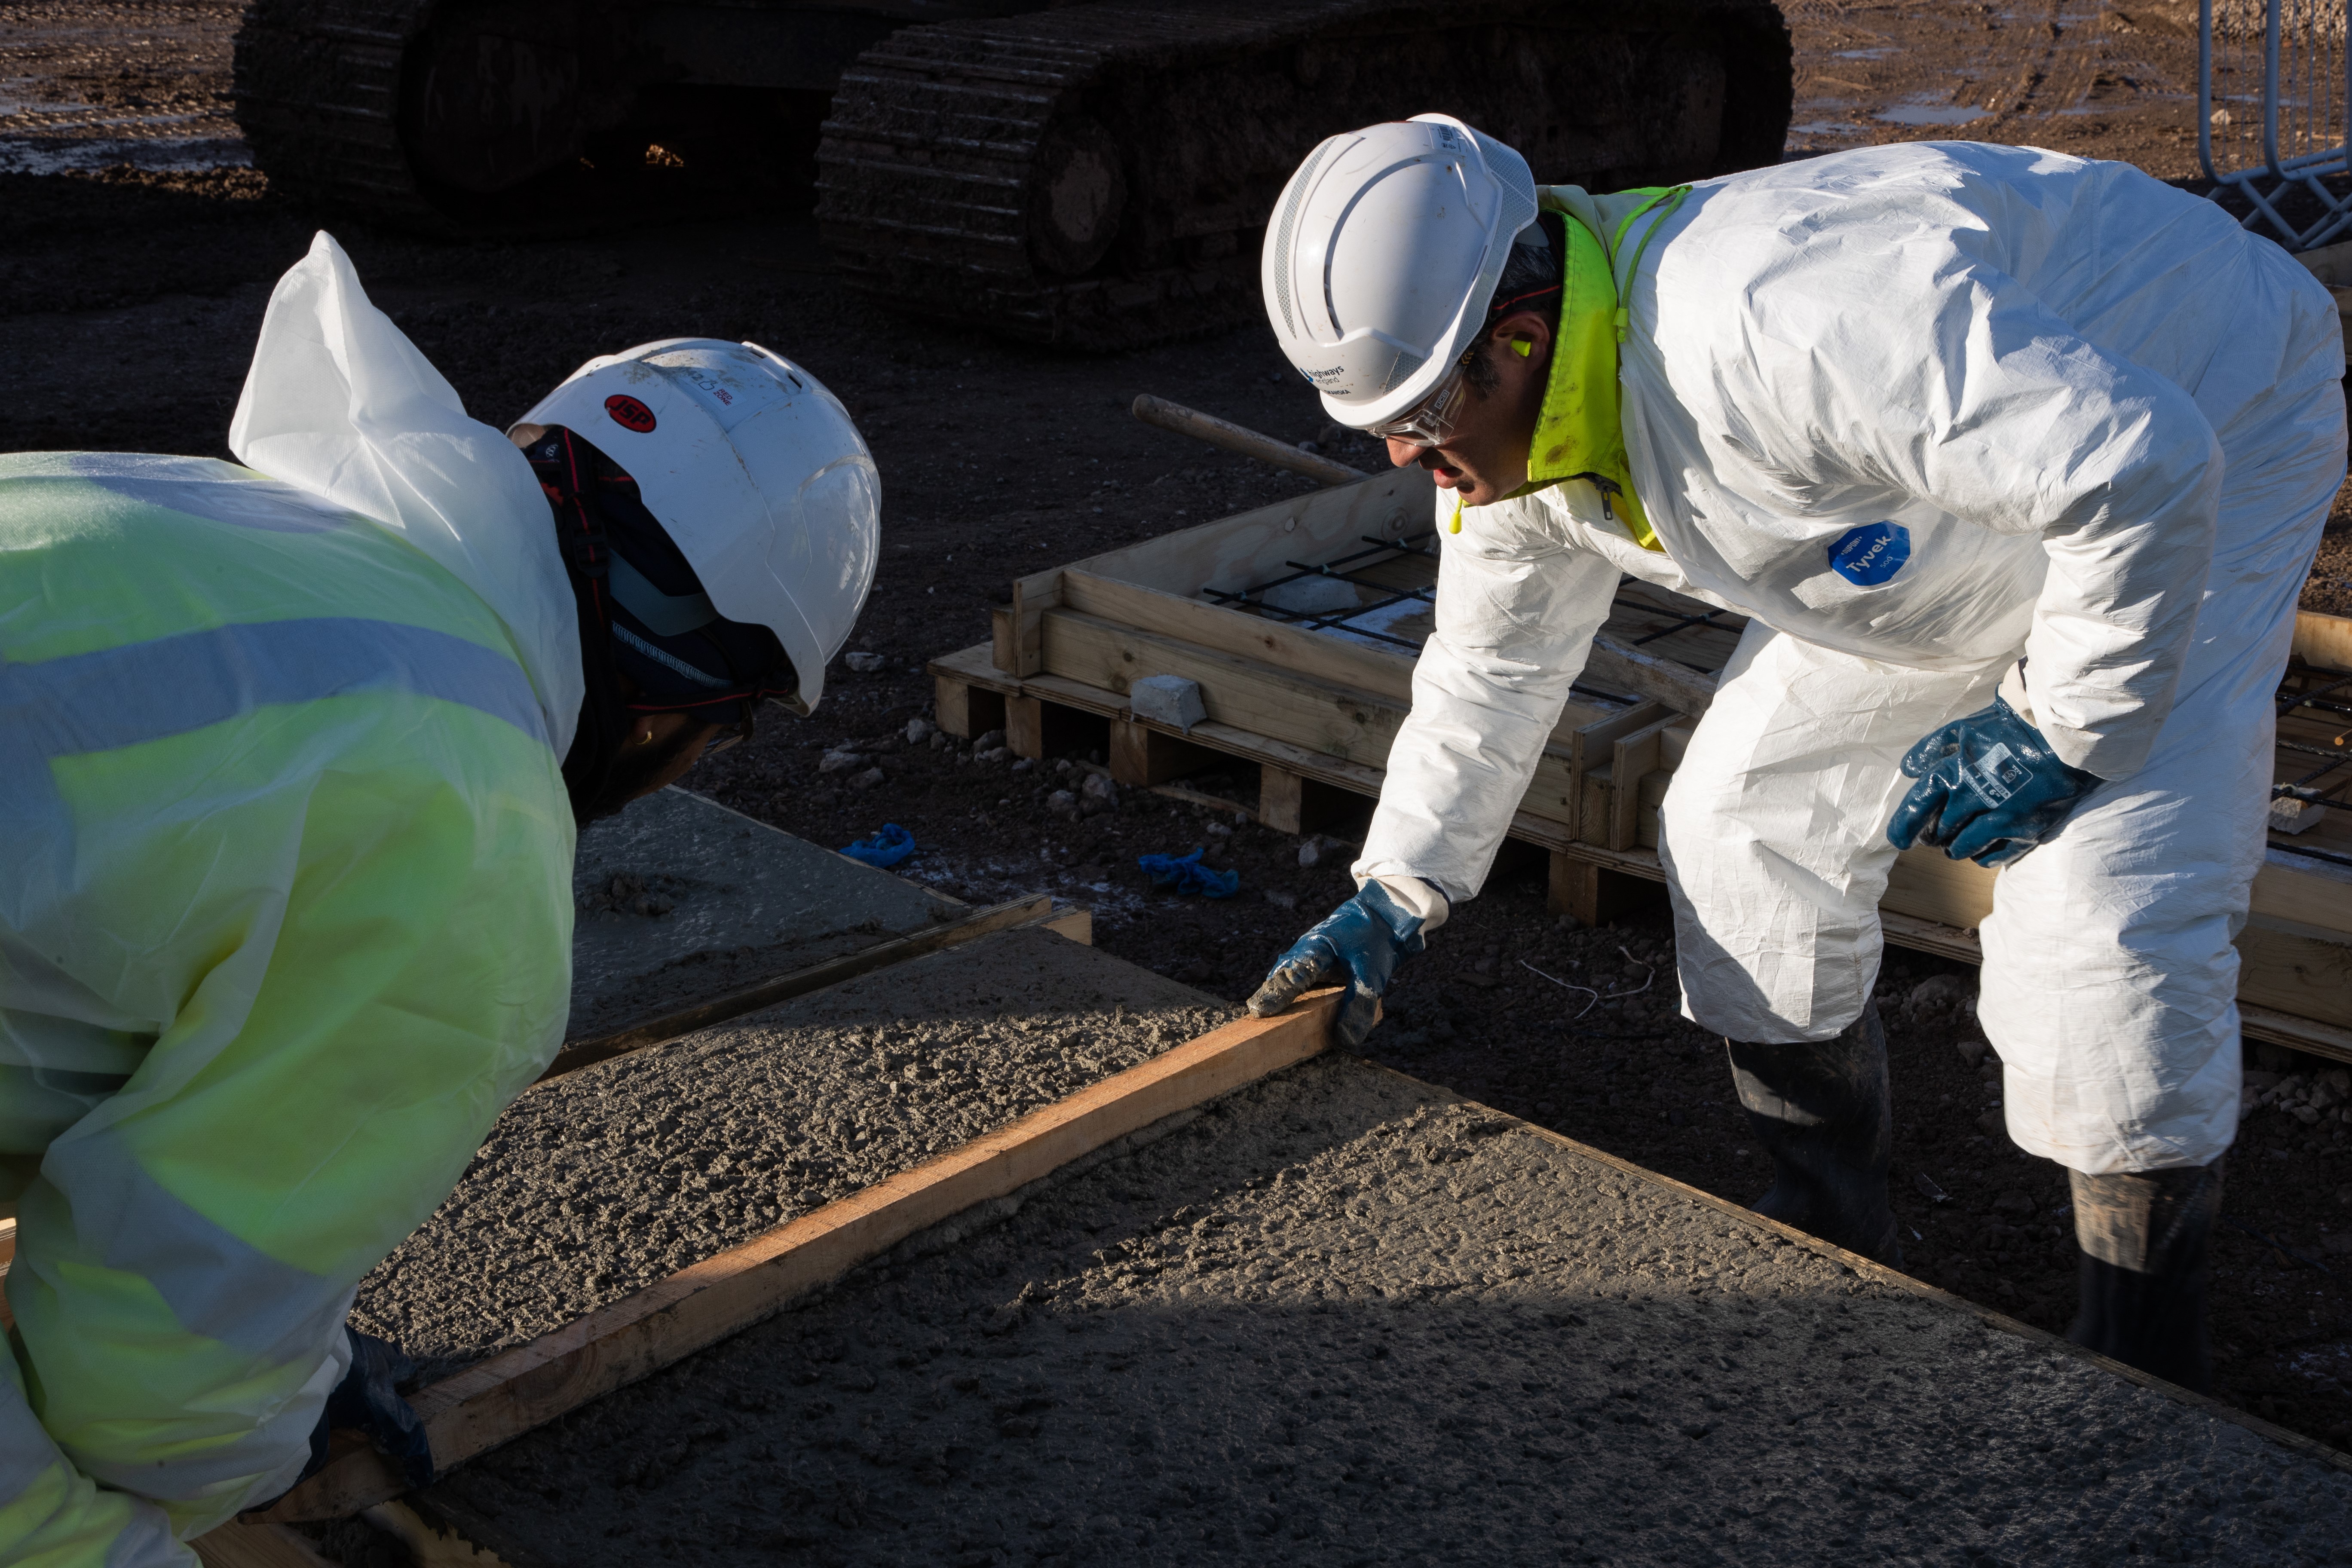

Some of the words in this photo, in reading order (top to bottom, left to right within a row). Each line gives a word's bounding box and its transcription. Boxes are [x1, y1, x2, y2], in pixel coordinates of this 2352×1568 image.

[1307, 366, 1344, 379] highways
[1315, 376, 1340, 386] england
[713, 391, 732, 406] ZONE
[719, 389, 733, 400] RED
[1437, 392, 1448, 407] JCB
[609, 400, 650, 425] JSP
[1842, 537, 1862, 554] DUPONT
[1846, 536, 1892, 573] Tyvek
[1880, 556, 1893, 569] 500
